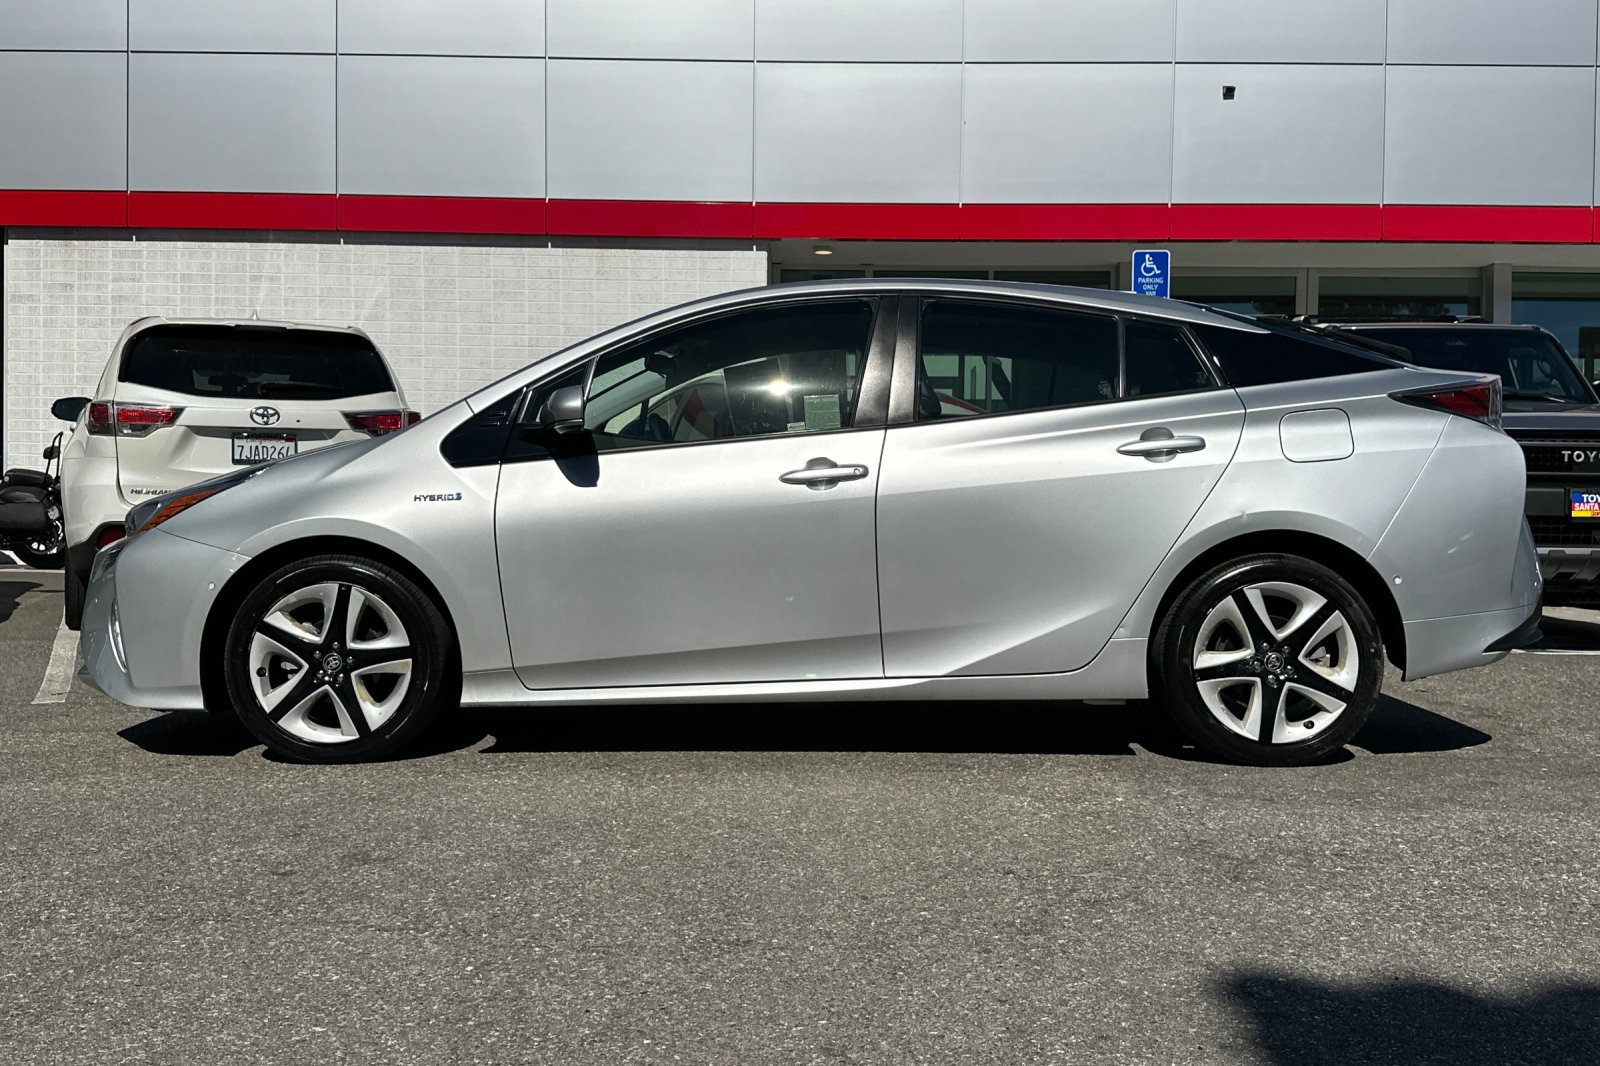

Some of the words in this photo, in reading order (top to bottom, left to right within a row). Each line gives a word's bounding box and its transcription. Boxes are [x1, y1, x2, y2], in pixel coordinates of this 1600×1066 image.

[1561, 450, 1600, 462] TOY
[413, 494, 455, 502] HYBRID
[1574, 503, 1599, 511] SANTA
